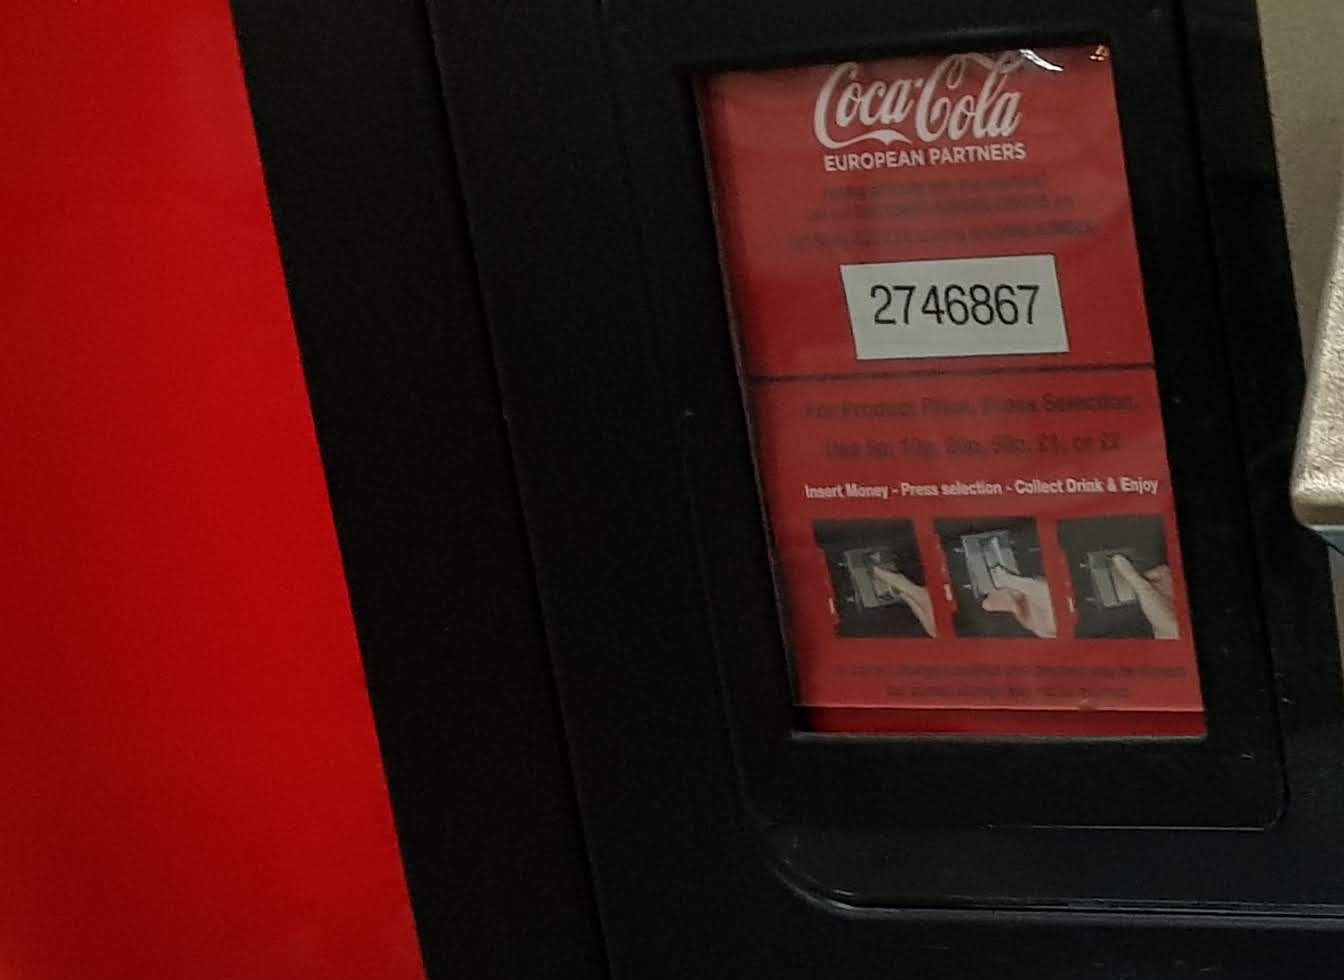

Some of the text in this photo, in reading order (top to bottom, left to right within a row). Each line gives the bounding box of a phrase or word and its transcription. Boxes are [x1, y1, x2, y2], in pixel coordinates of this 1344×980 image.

[813, 52, 1025, 149] Coca-Cola
[823, 143, 1027, 172] EUROPEAN PARTNERS
[869, 284, 1040, 326] 2746867
[804, 483, 844, 499] Insert
[845, 482, 889, 499] Money
[900, 481, 939, 497] Press
[941, 480, 1003, 496] selection
[1014, 478, 1064, 495] Collect
[1065, 477, 1105, 494] Drink
[1107, 476, 1118, 492] &
[1119, 475, 1159, 496] Enjoy
